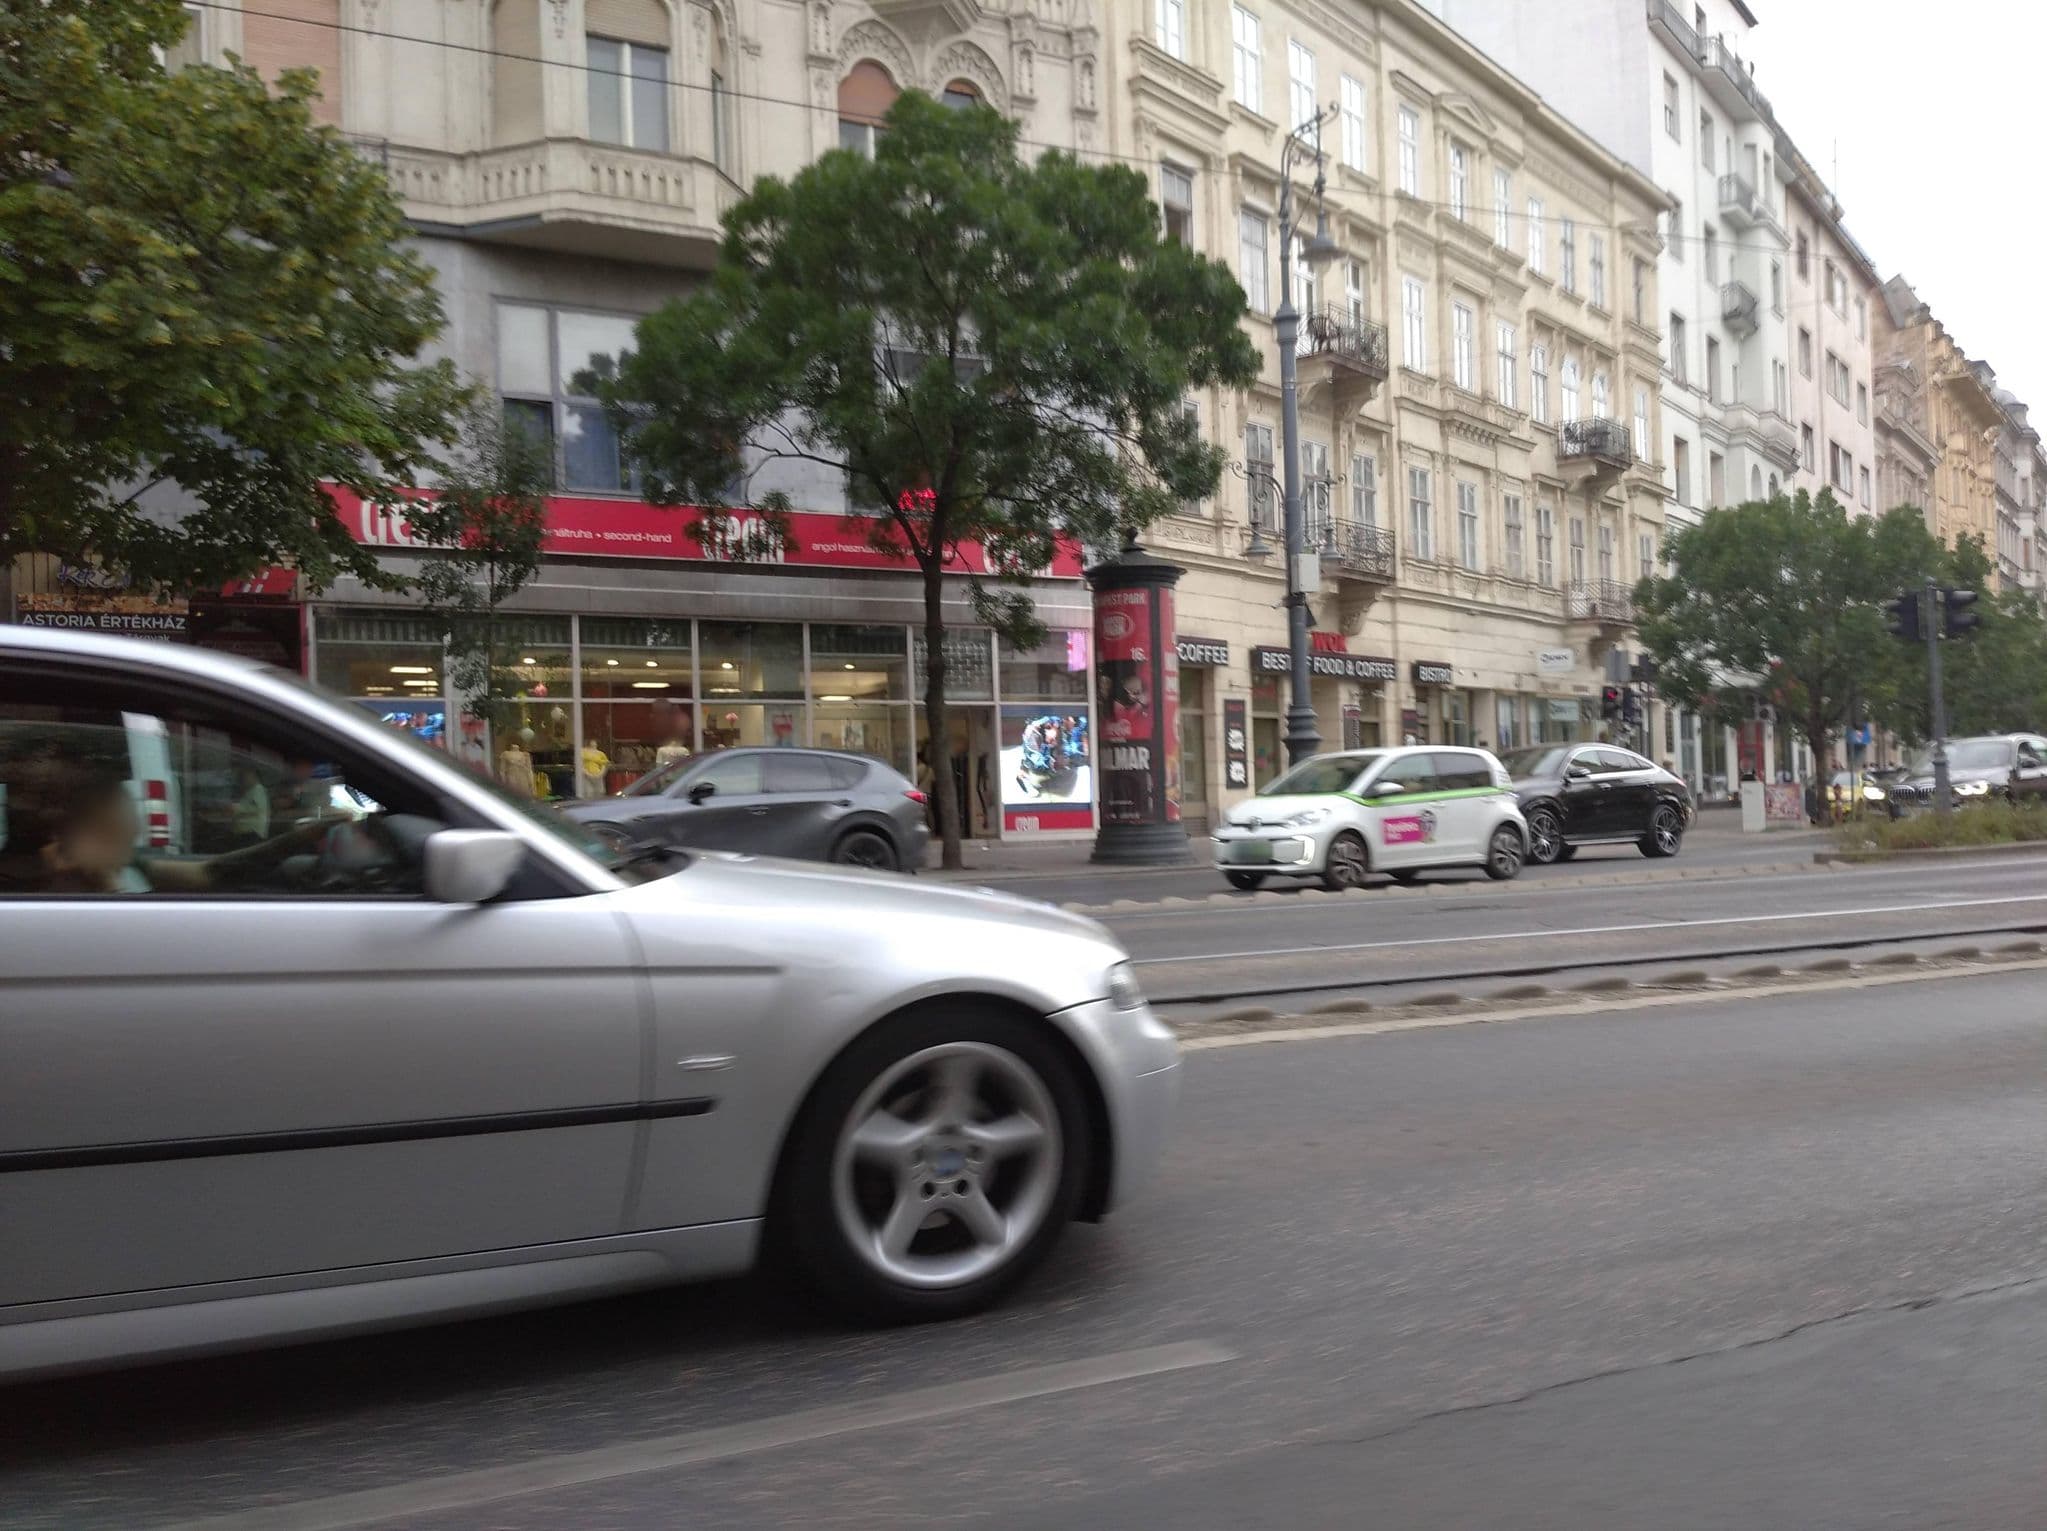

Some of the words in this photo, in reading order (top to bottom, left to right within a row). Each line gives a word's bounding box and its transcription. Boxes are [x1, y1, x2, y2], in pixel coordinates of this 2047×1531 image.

[604, 531, 672, 543] second-hand
[812, 542, 836, 554] angol
[23, 614, 96, 627] ASTORIA
[101, 613, 186, 630] ÉRTÉKHÁZ
[1178, 643, 1228, 665] COFFEE
[1313, 657, 1345, 675] FOOD
[1346, 660, 1355, 676] &
[1356, 661, 1395, 679] COFFEE
[1418, 665, 1451, 682] BISTRO
